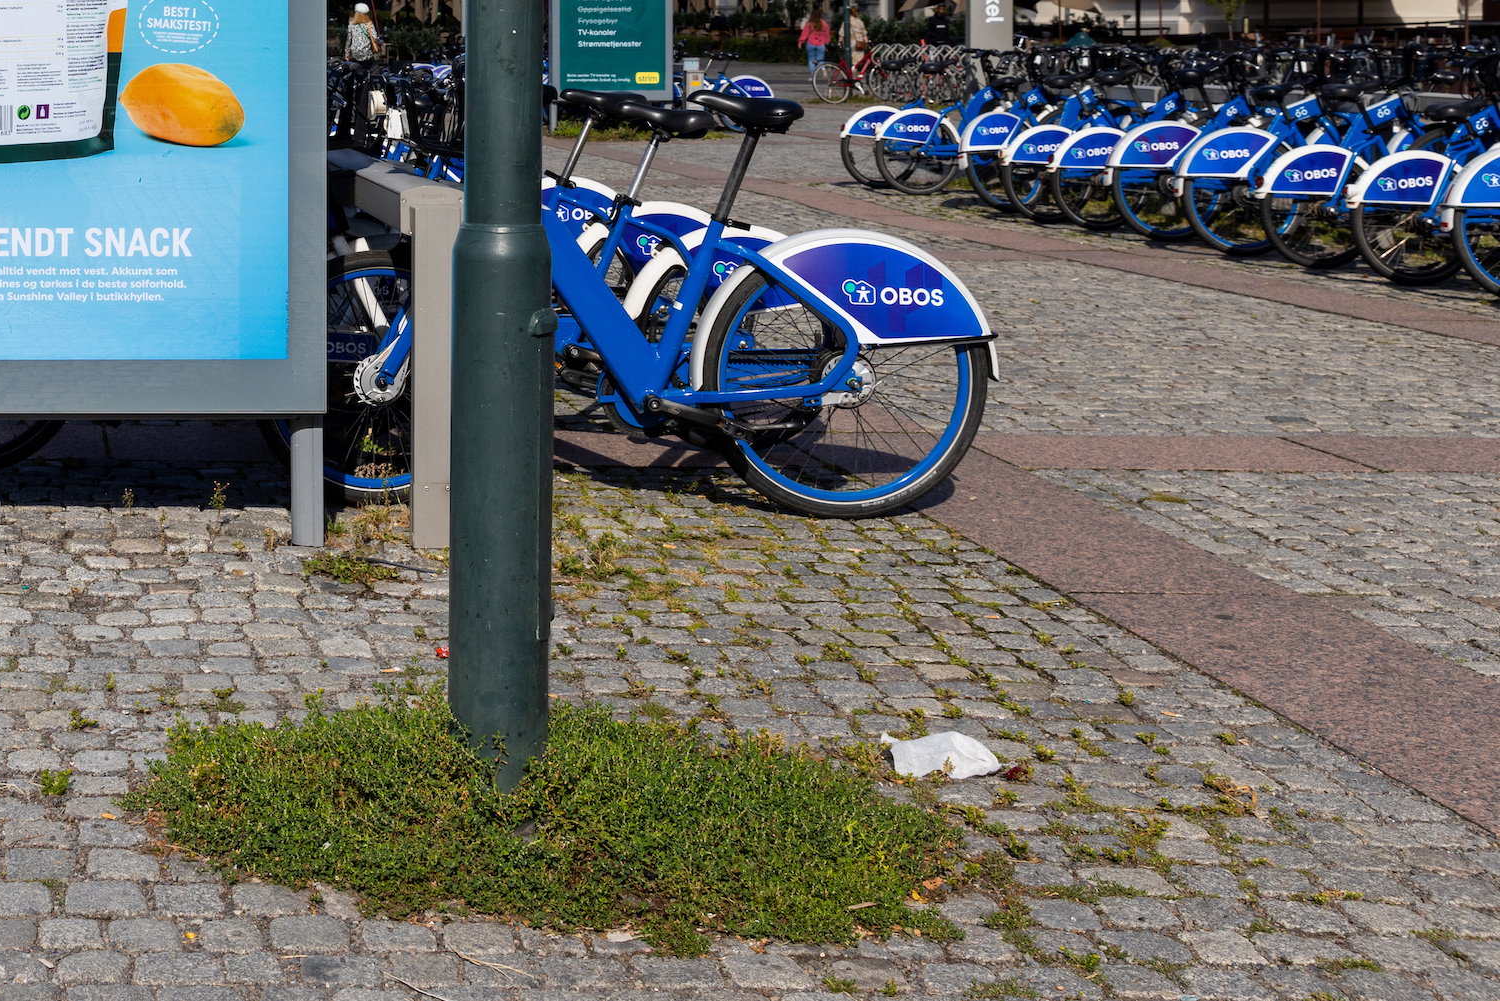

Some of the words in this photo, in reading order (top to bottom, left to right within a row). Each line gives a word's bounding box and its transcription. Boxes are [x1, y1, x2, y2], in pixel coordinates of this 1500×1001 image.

[163, 6, 190, 18] BEST
[192, 7, 197, 18] I
[146, 17, 211, 32] SMAKSTEST!
[577, 28, 617, 36] TV-kanaler
[577, 40, 643, 49] Strømmetjenester
[907, 124, 930, 132] OBOS
[989, 126, 1009, 134] OBOS
[1151, 141, 1179, 151] OBOS
[1220, 148, 1250, 159] OBOS
[1304, 167, 1338, 181] OBOS
[1398, 176, 1434, 189] OBOS
[84, 227, 193, 257] SNACK
[26, 266, 56, 275] vendt
[59, 267, 80, 275] mot
[83, 267, 109, 275] vest.
[111, 266, 153, 275] Akkurat
[23, 280, 37, 290] og
[40, 280, 73, 288] tørkes
[81, 279, 95, 288] de
[97, 279, 127, 288] beste
[130, 279, 187, 288] solforhold.
[6, 292, 54, 301] Sunshine
[57, 292, 88, 303] Valley
[96, 292, 164, 303] butikkhyllen.
[880, 286, 944, 307] OBOS
